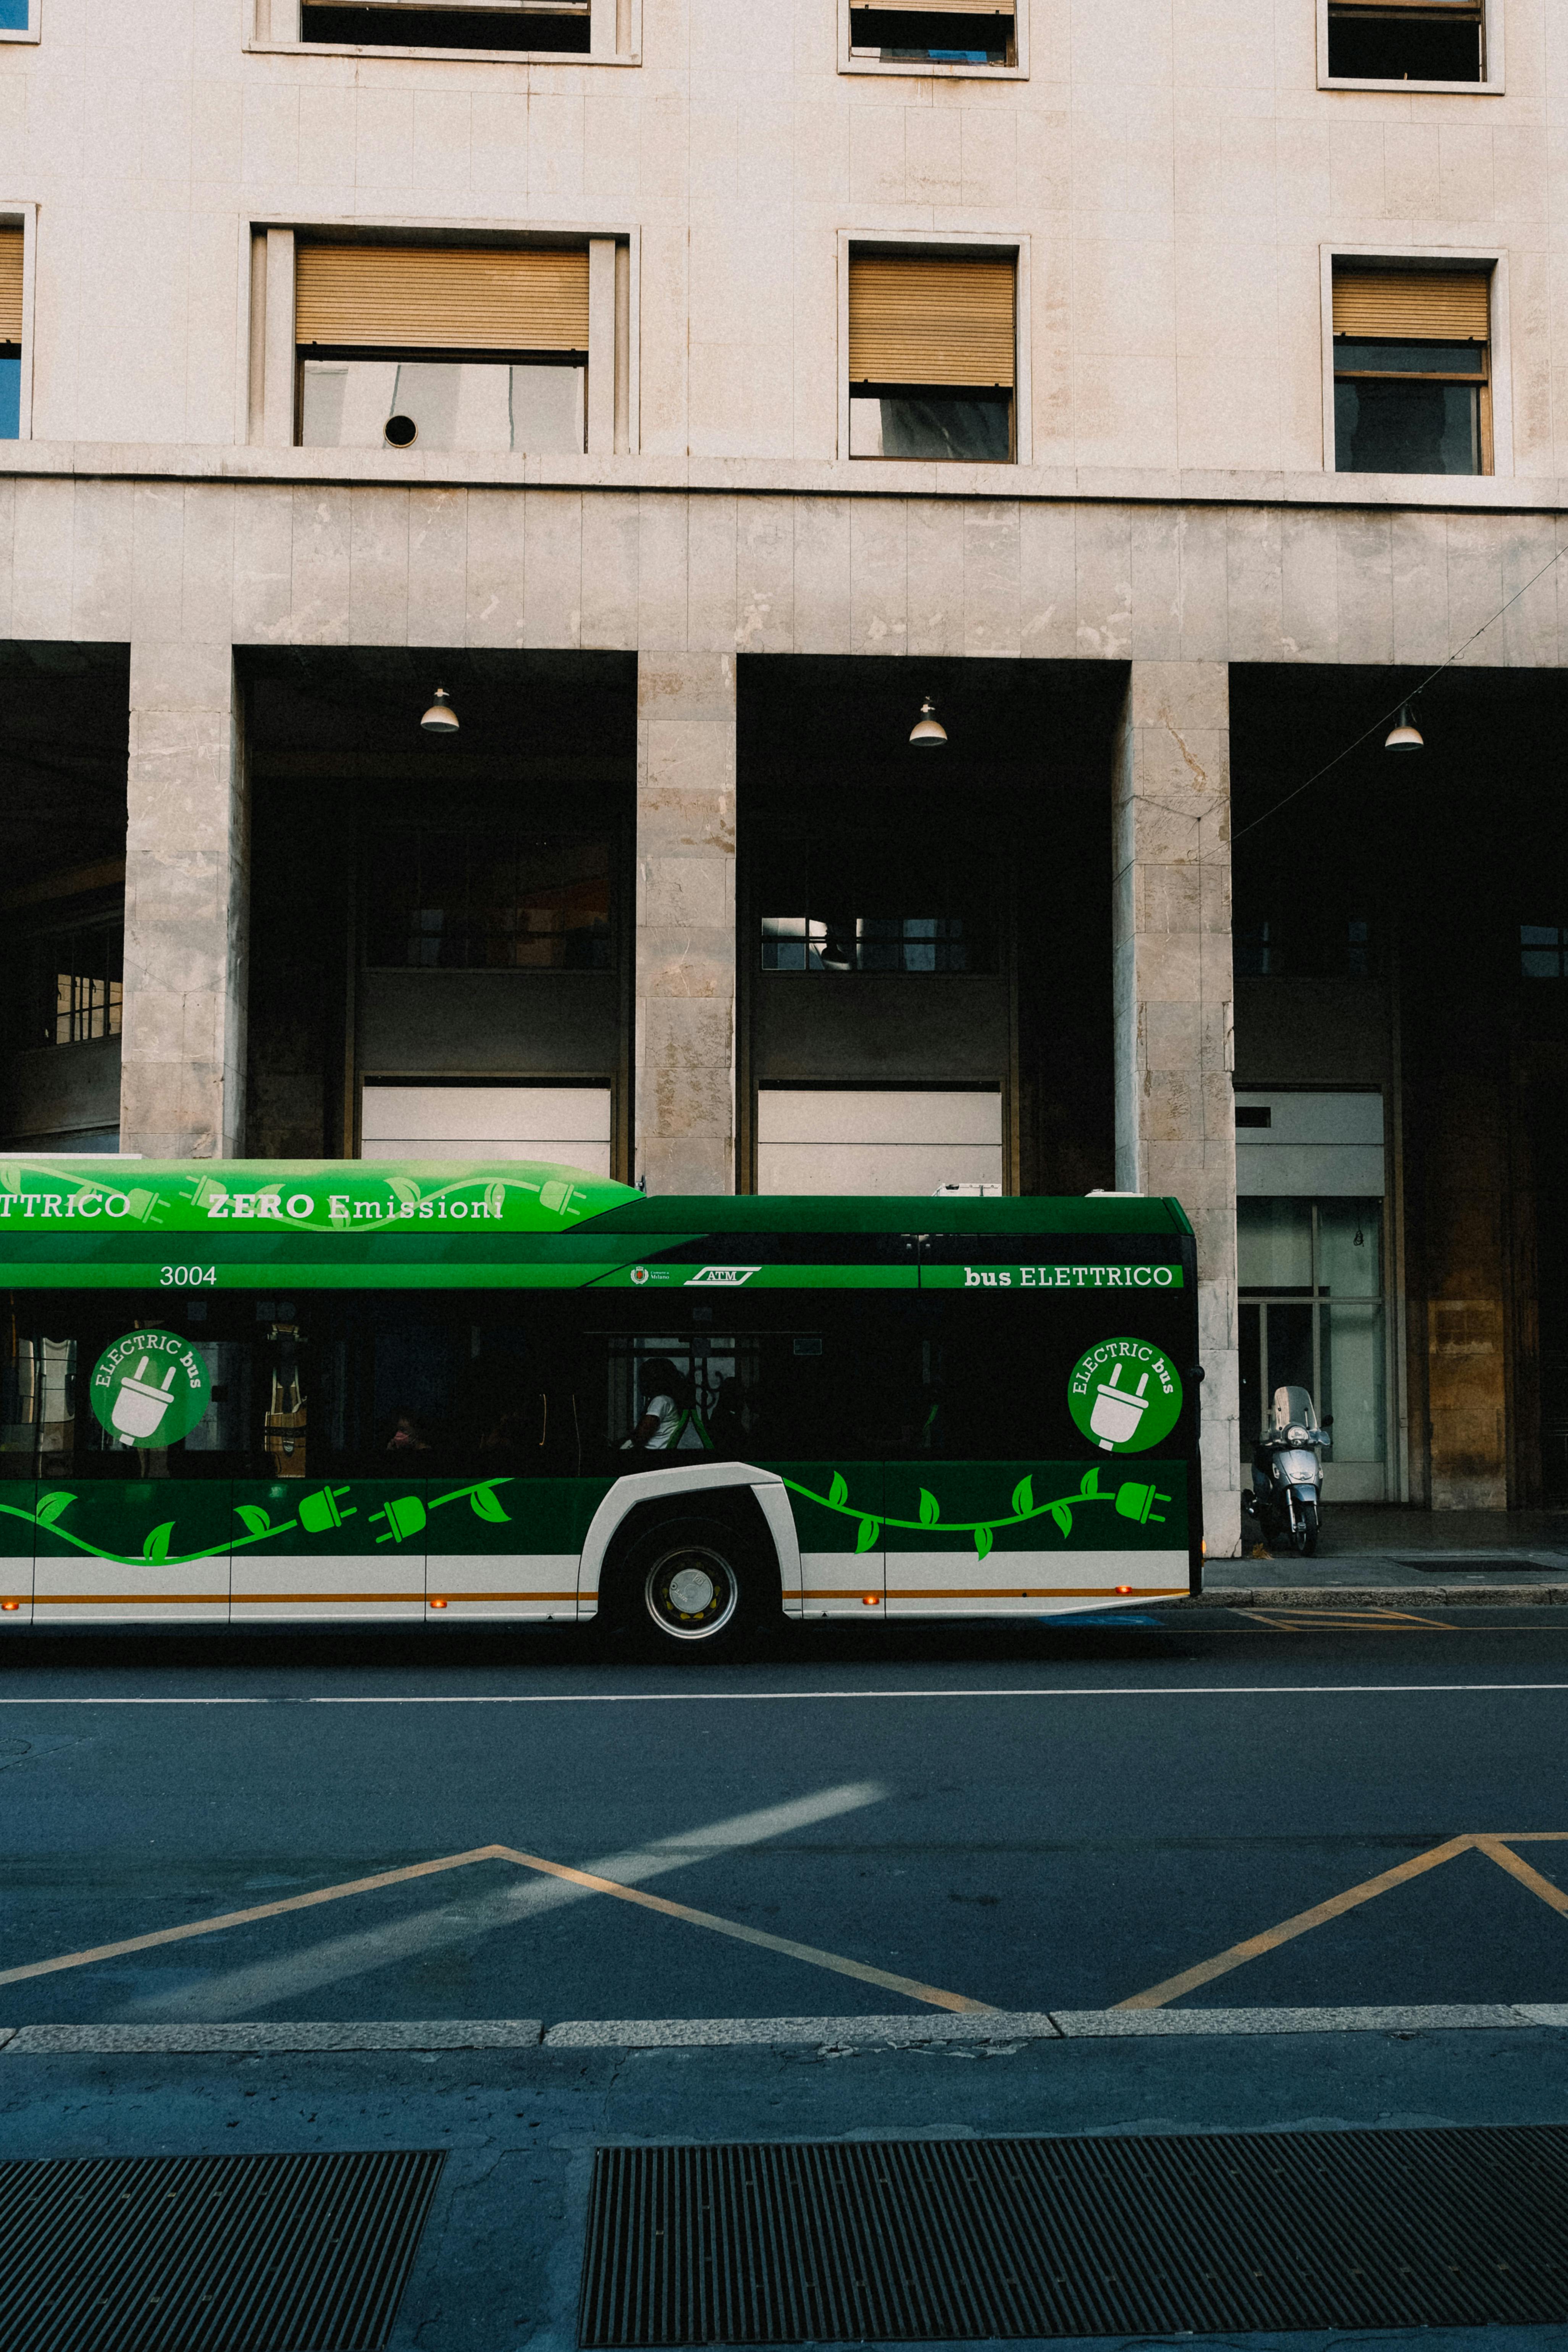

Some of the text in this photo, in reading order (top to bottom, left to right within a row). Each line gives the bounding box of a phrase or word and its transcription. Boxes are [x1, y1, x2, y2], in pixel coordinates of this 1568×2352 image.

[207, 1194, 504, 1219] ZERO Emissioni
[160, 1266, 217, 1285] 3004
[706, 1271, 737, 1281] ATM
[964, 1267, 1172, 1286] bus ELETTRICO
[95, 1334, 201, 1389] ELECTRIC bus
[1072, 1342, 1174, 1395] ELECTRIC bus
